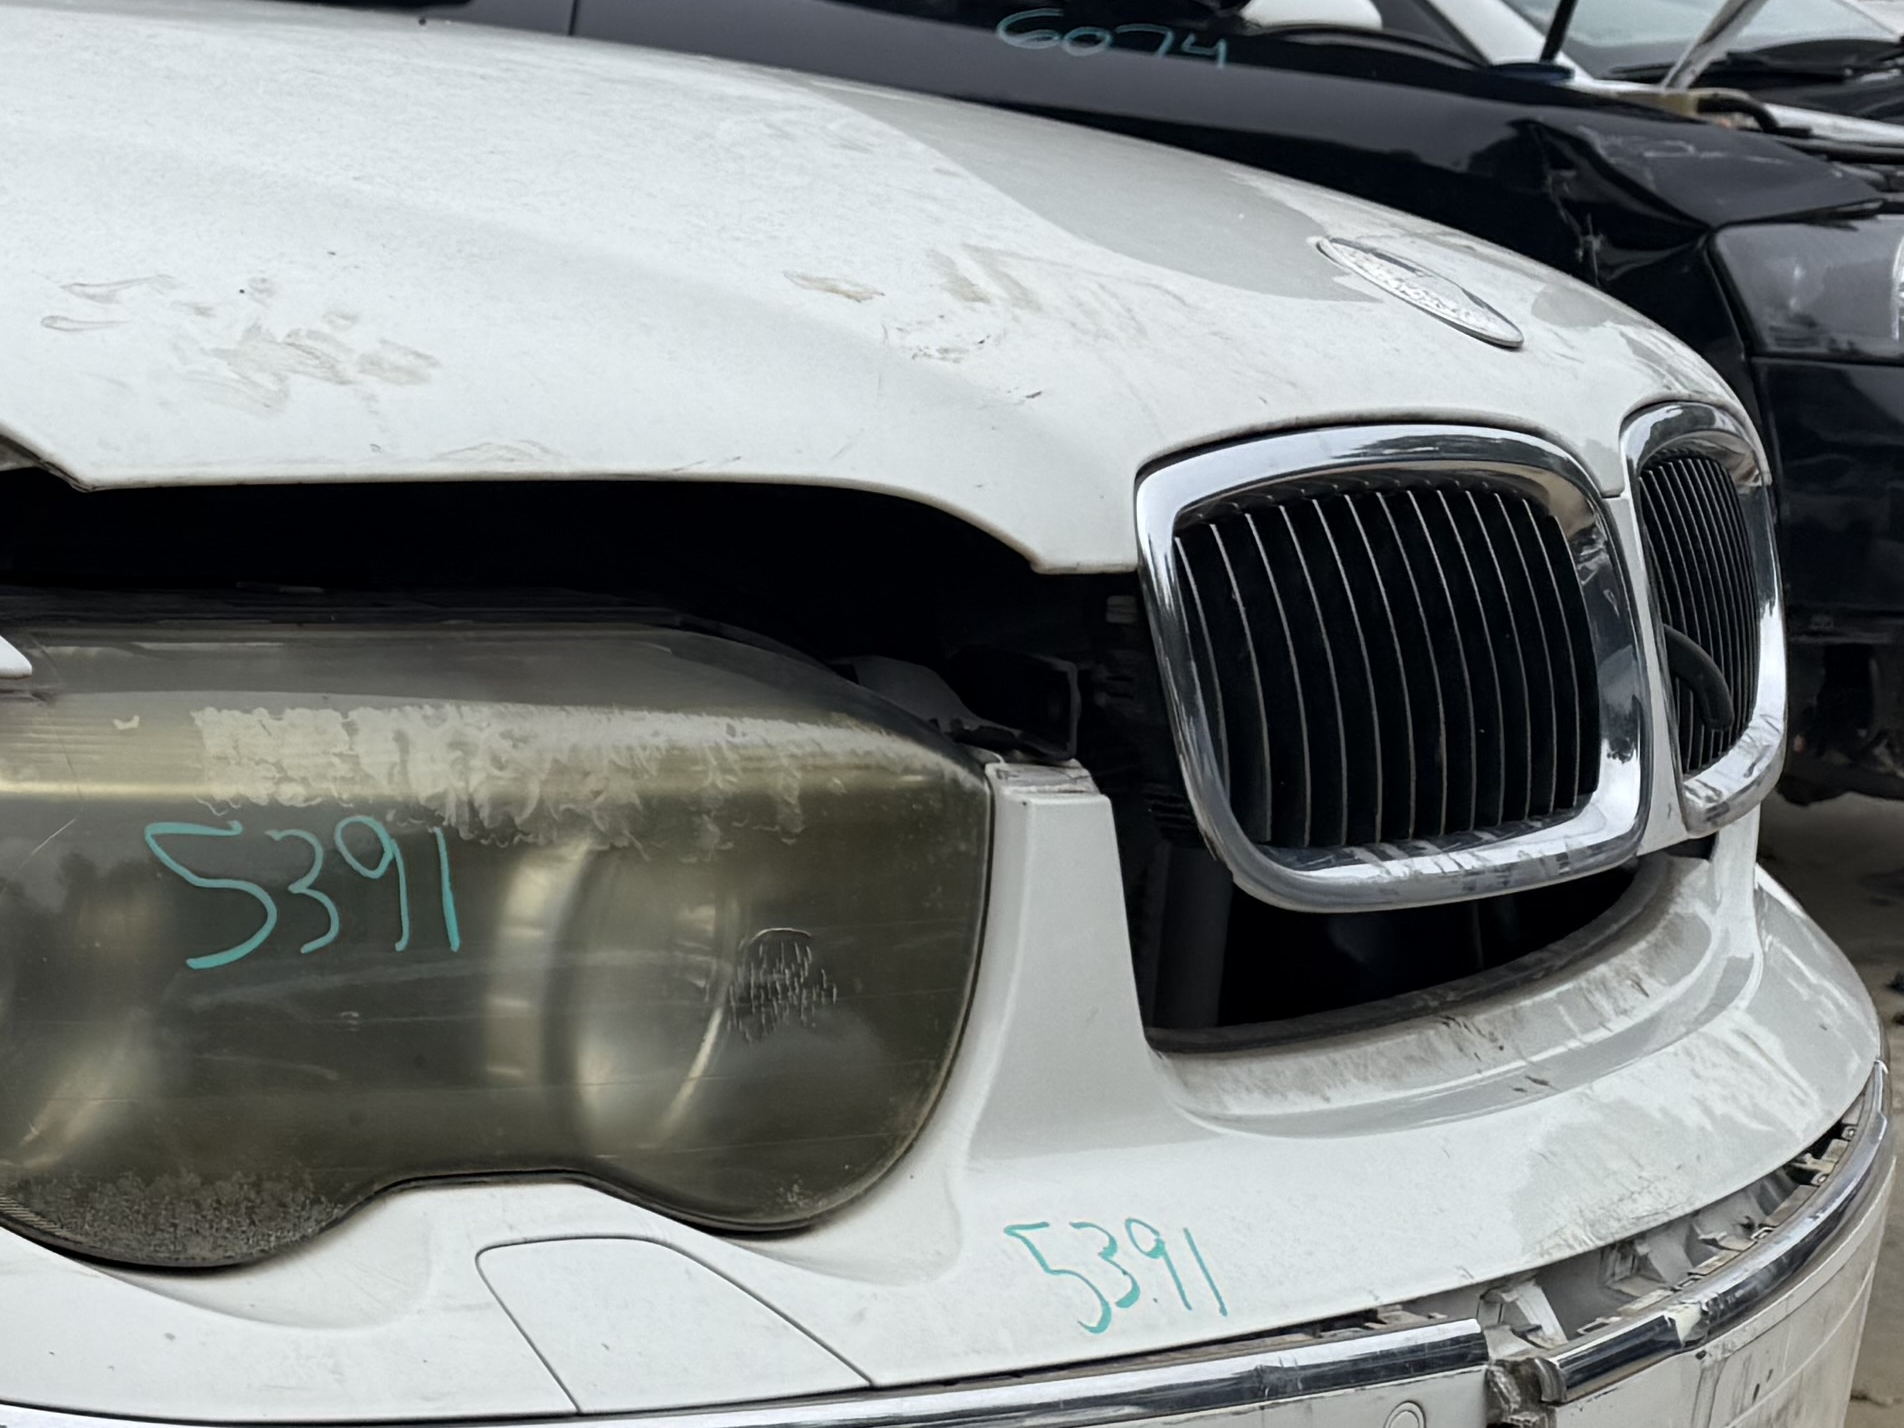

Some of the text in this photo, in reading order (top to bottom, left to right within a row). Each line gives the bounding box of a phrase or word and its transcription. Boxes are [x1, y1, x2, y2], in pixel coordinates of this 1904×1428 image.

[996, 8, 1228, 69] 6074
[143, 815, 461, 970] 5391
[1003, 1217, 1228, 1335] 5391
